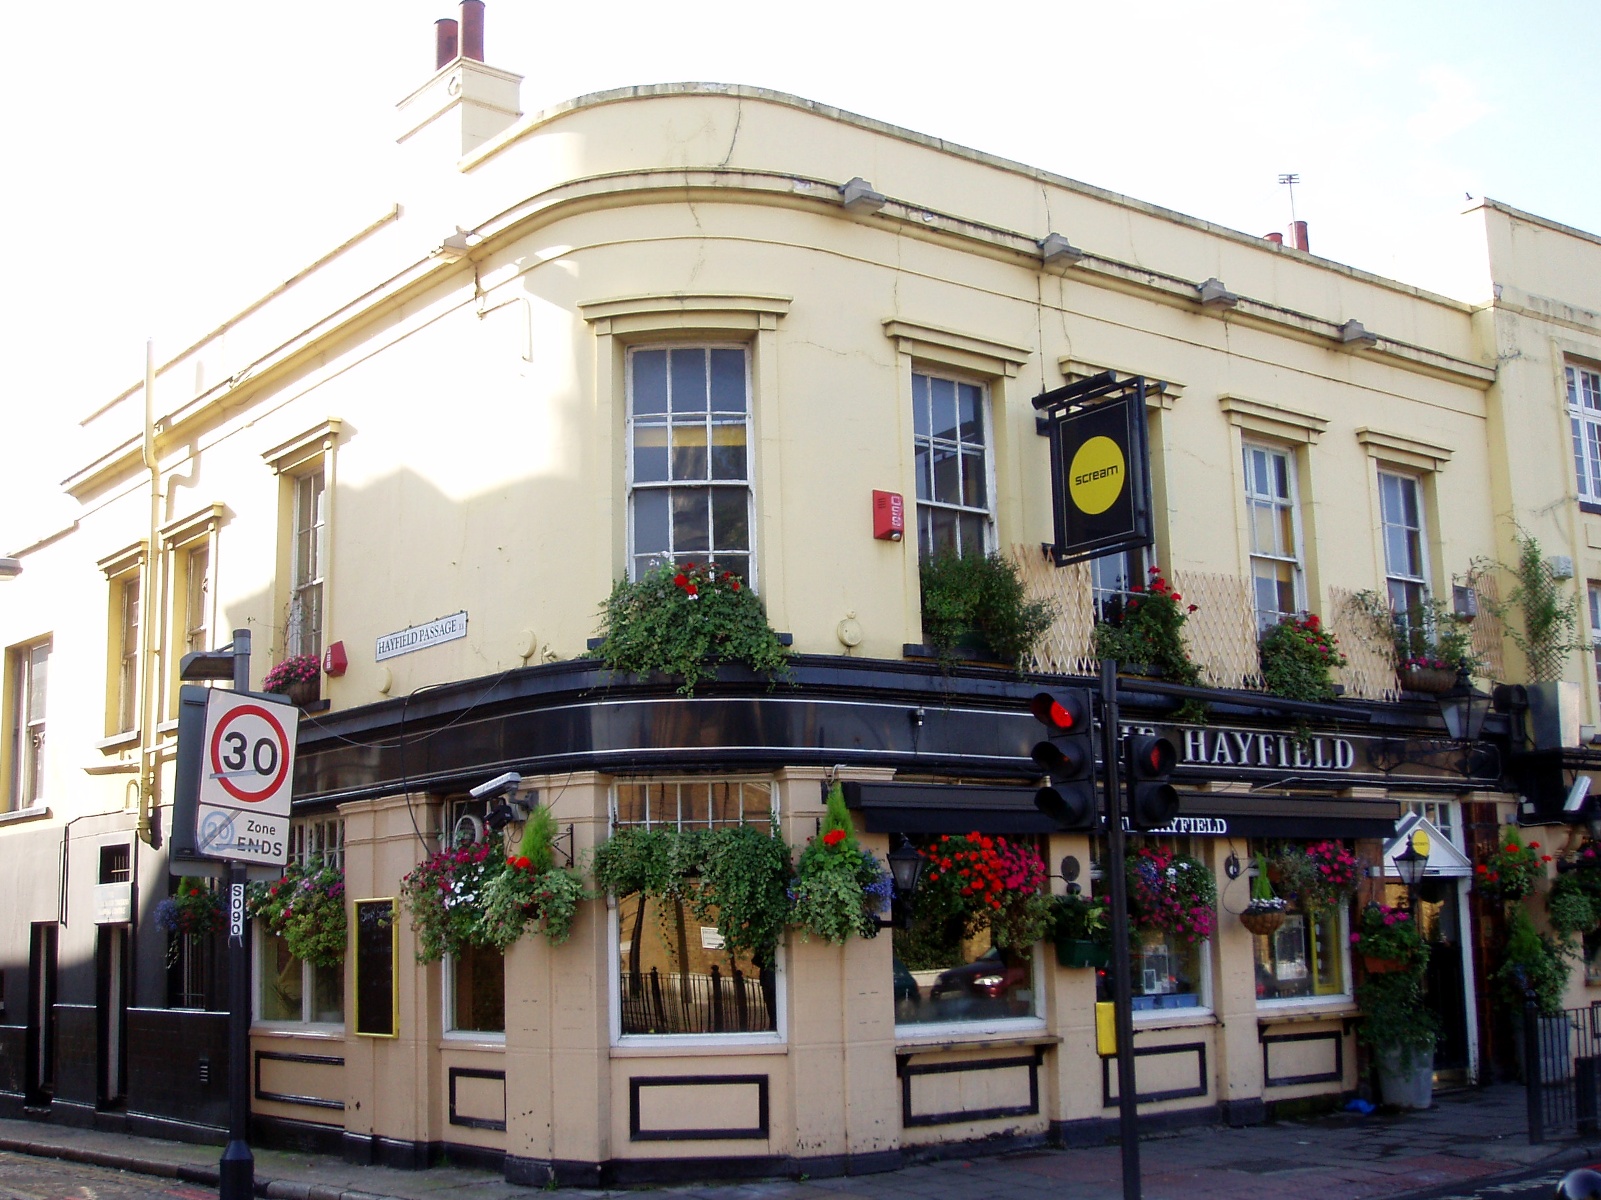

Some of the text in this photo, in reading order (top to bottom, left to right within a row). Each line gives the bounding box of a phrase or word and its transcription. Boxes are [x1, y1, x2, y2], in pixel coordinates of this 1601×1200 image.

[1075, 464, 1119, 486] scream
[378, 631, 418, 654] HAYFIELD
[419, 619, 457, 642] PASSAGE
[222, 731, 278, 776] 30
[1182, 728, 1354, 770] HAYFIELD
[247, 820, 277, 836] Zone
[237, 836, 283, 857] ENDS
[231, 885, 242, 935] S090
